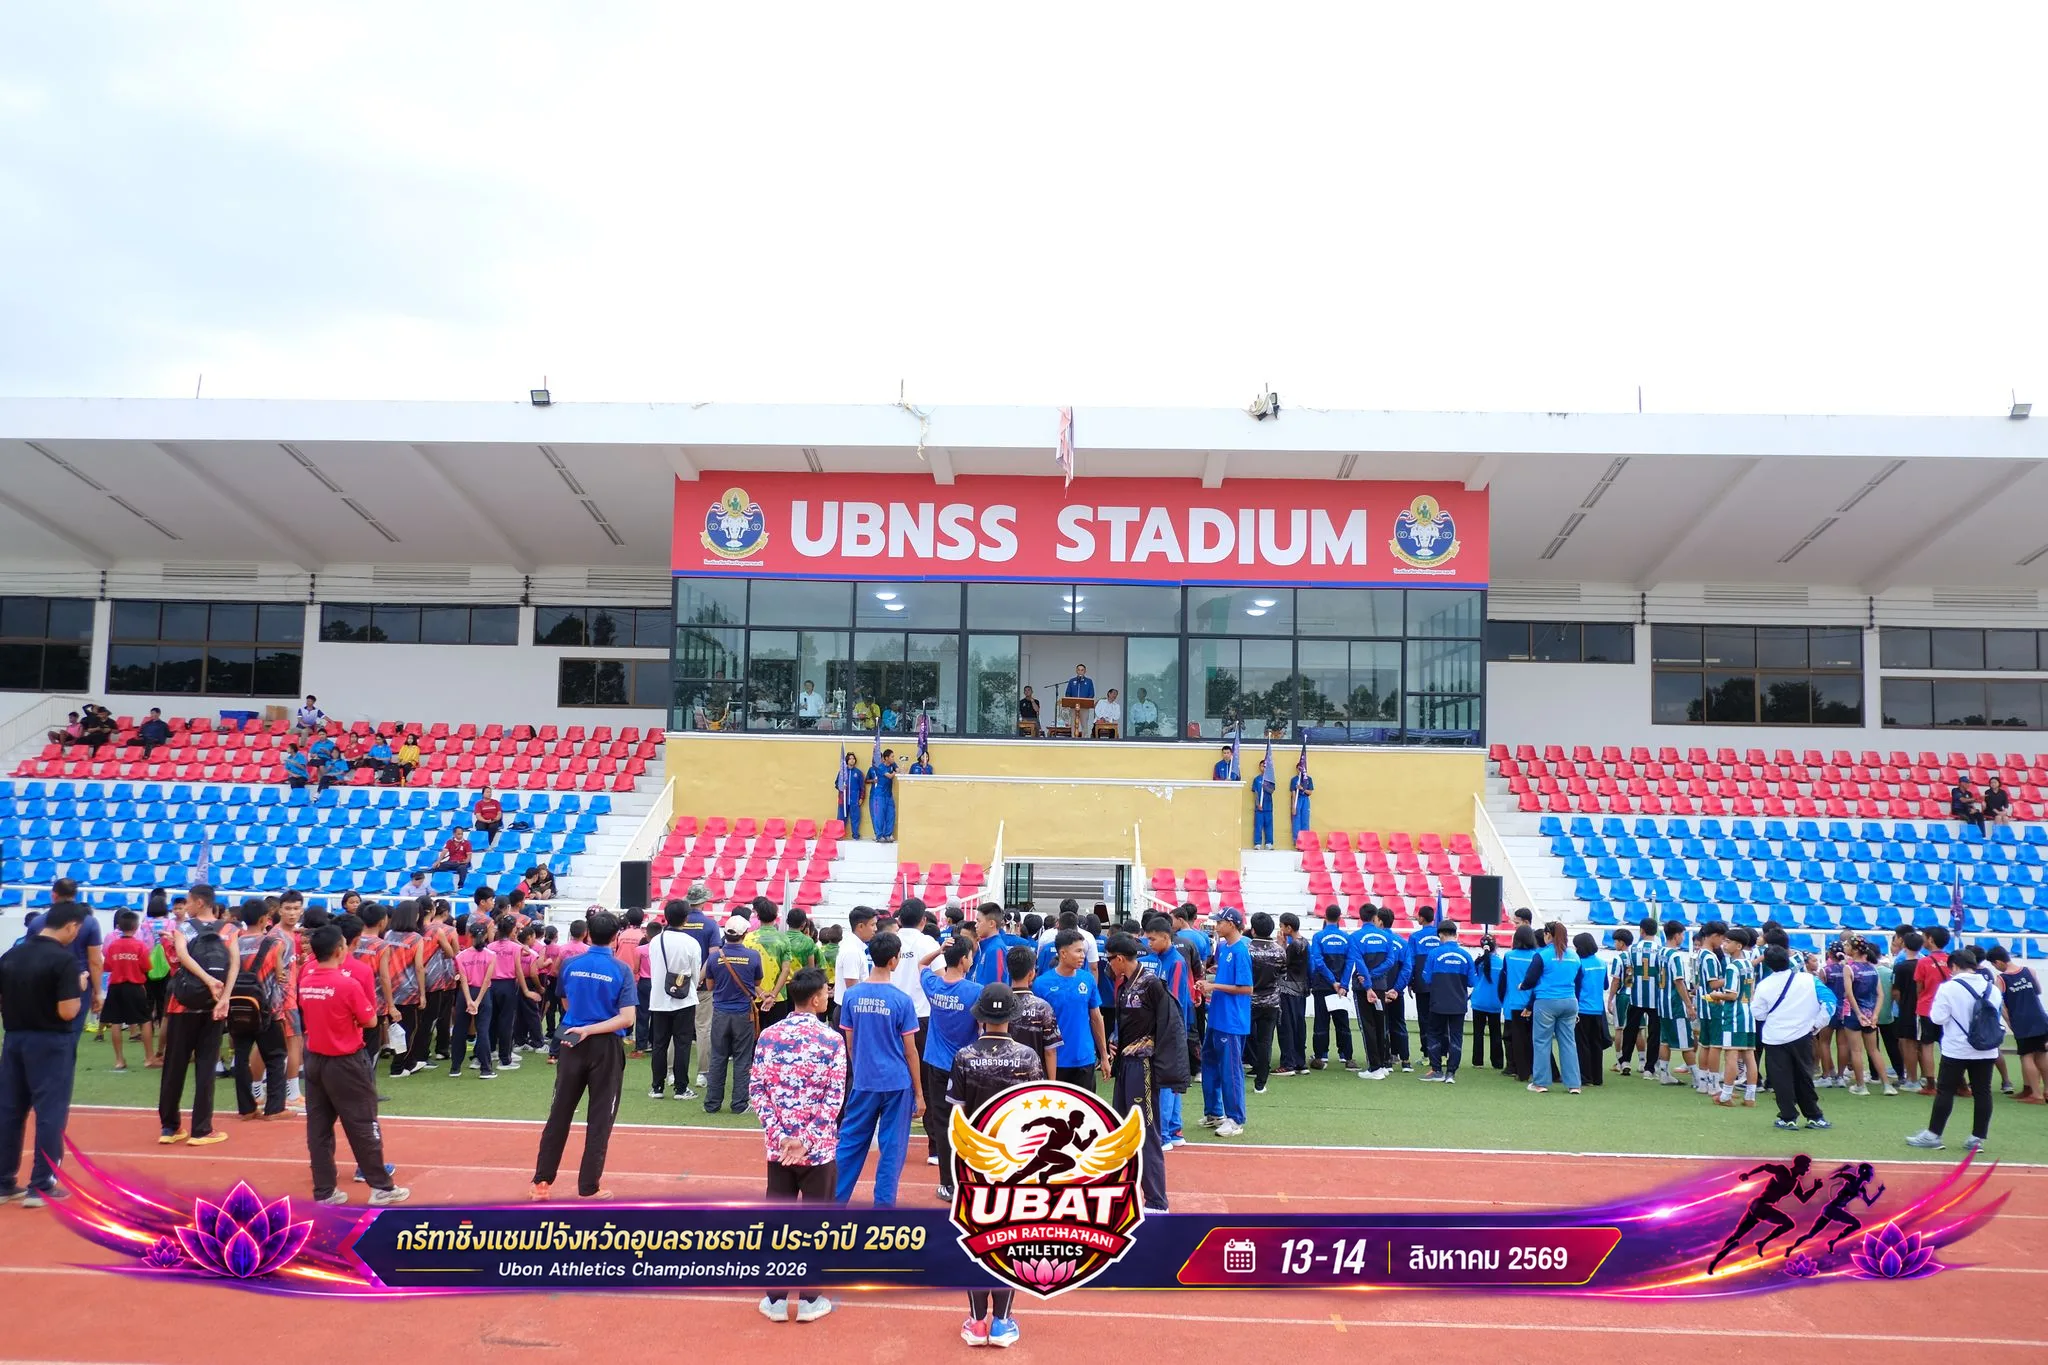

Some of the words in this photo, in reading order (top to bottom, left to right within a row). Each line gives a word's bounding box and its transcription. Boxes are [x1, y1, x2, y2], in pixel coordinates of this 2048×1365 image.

[790, 500, 1019, 563] UBNSS
[1055, 504, 1367, 566] STADIUM
[1642, 958, 1650, 980] 1
[858, 997, 886, 1007] UBNSS
[934, 993, 959, 1003] UBNSS
[853, 1005, 891, 1016] THAILAND
[930, 998, 965, 1011] THAILAND
[970, 1057, 1021, 1069] อุบลราชธานี
